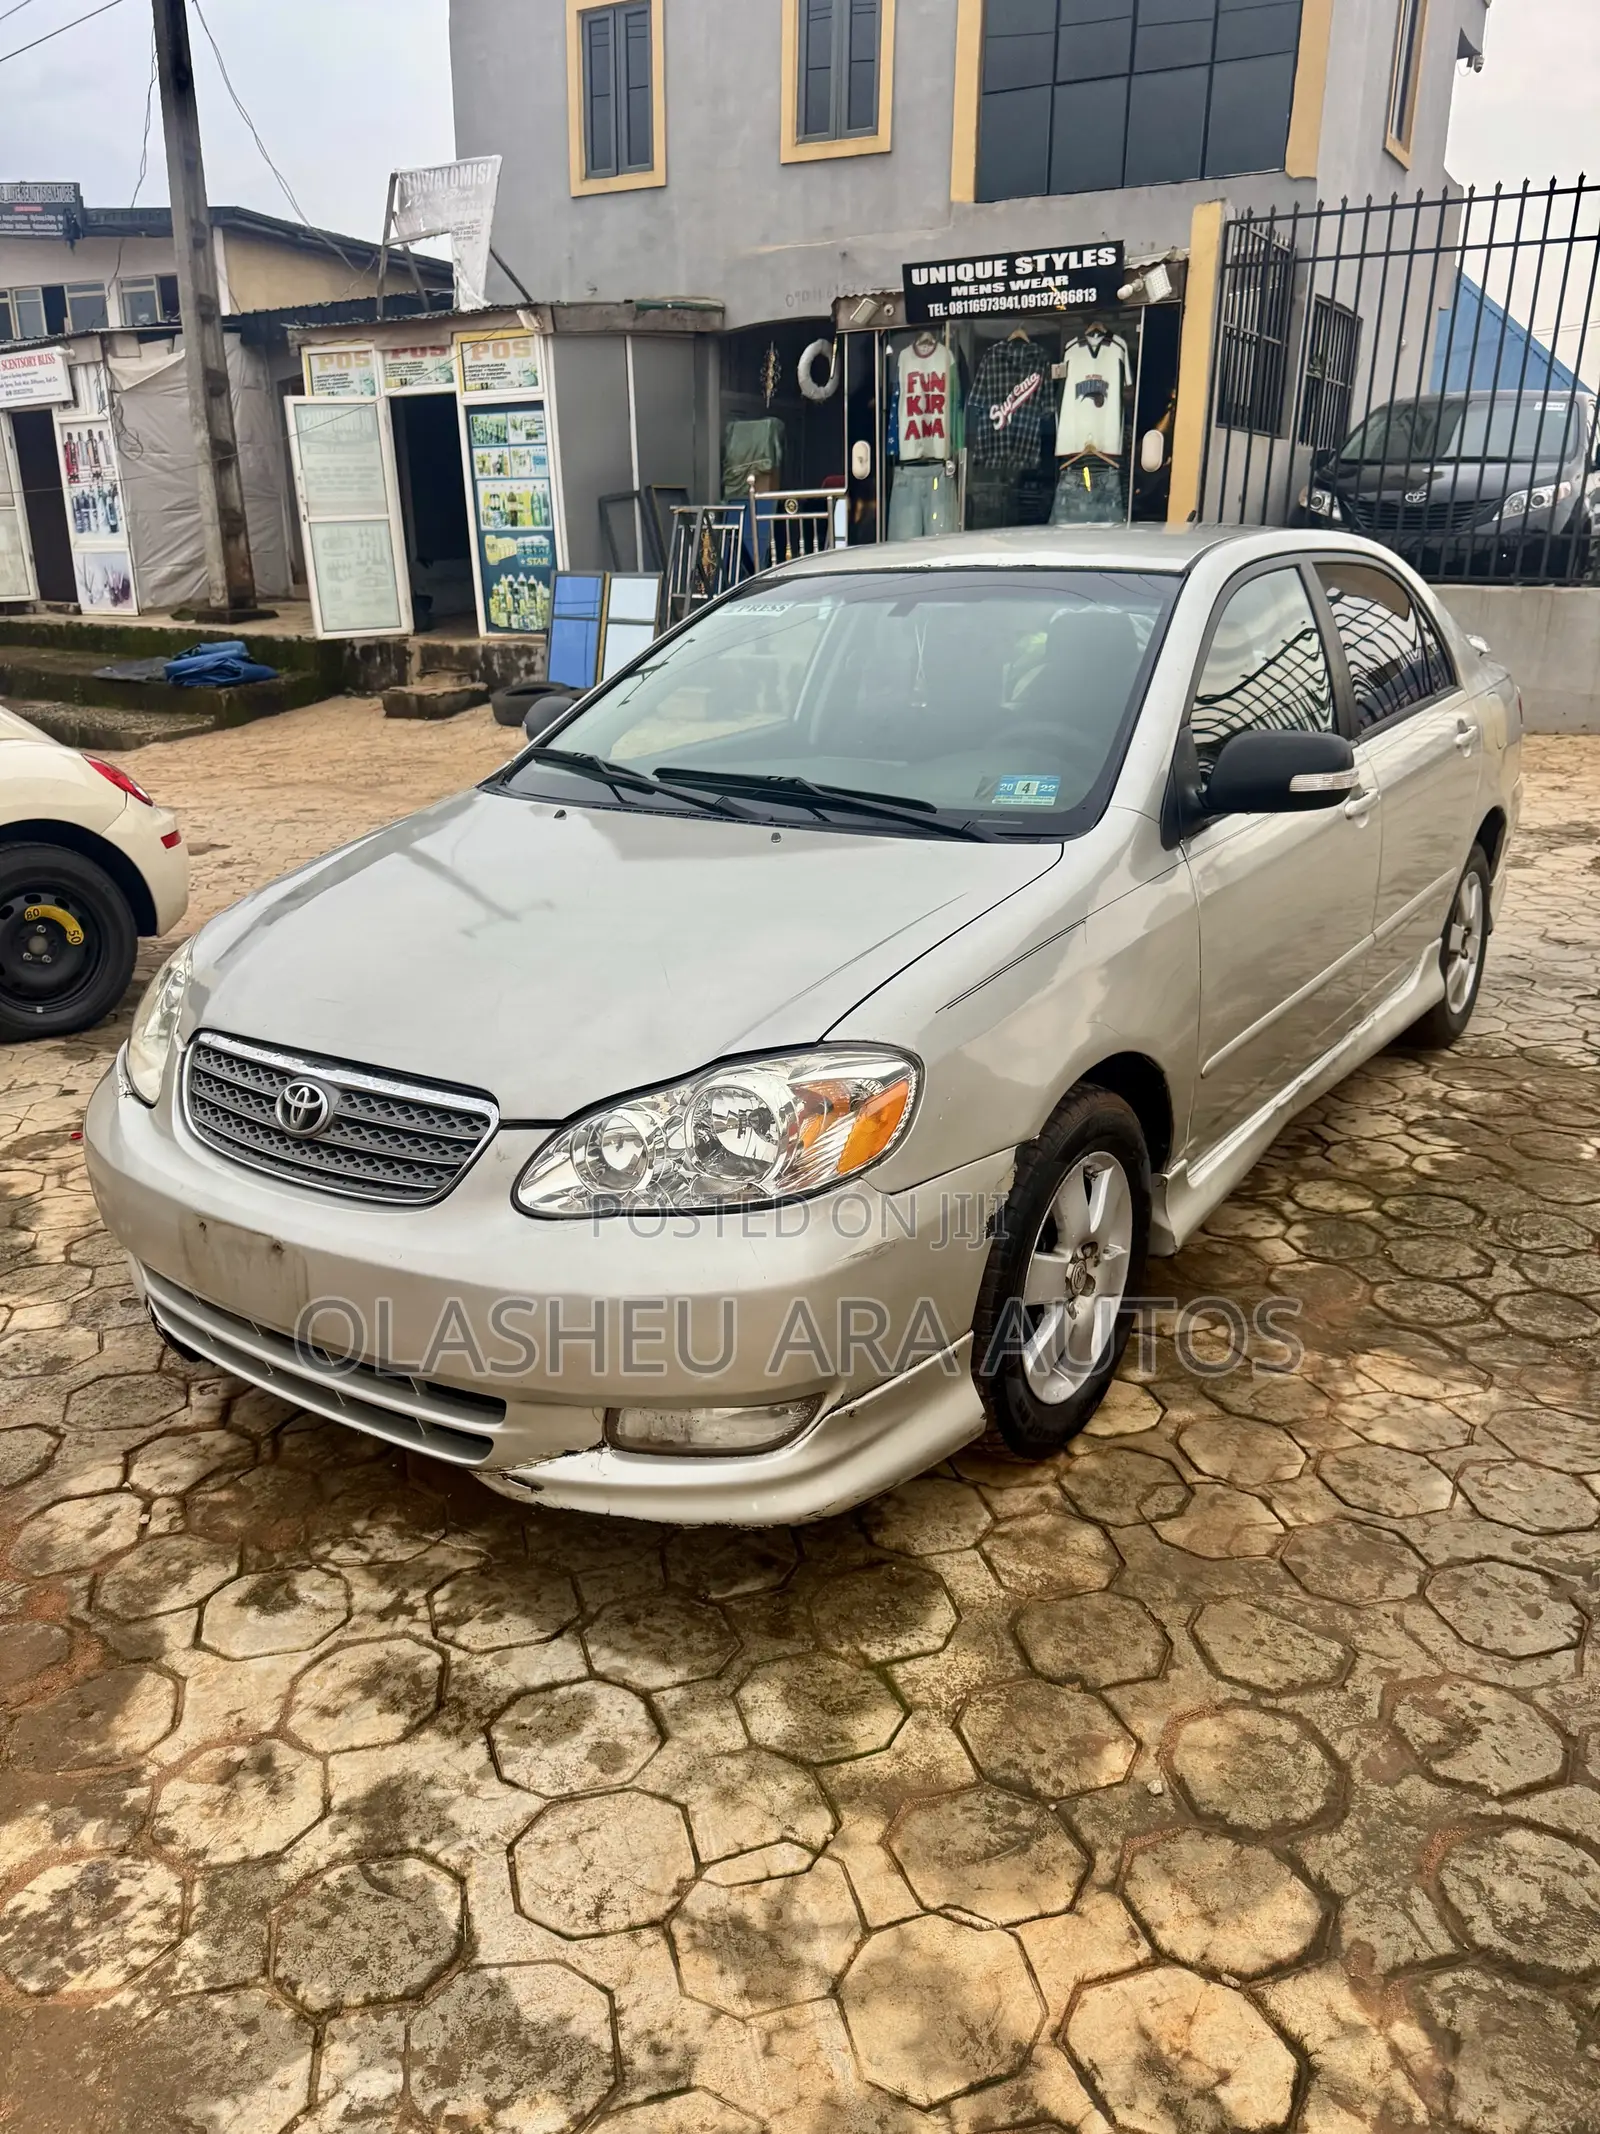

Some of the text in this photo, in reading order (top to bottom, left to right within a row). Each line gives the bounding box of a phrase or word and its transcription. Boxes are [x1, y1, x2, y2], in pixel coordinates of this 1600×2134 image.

[911, 247, 1117, 286] UNIQUE STYLES
[951, 275, 1069, 297] MENS WEAR
[471, 340, 531, 361] POS
[1, 353, 56, 371] SCENTSORY BLISS
[318, 351, 371, 372] POS
[907, 371, 946, 394] FUN
[907, 394, 946, 417] KIR
[904, 418, 945, 441] AMA
[526, 557, 549, 566] STAR
[1000, 782, 1056, 794] 20 4 22
[26, 908, 40, 920] 80
[68, 930, 82, 944] 50
